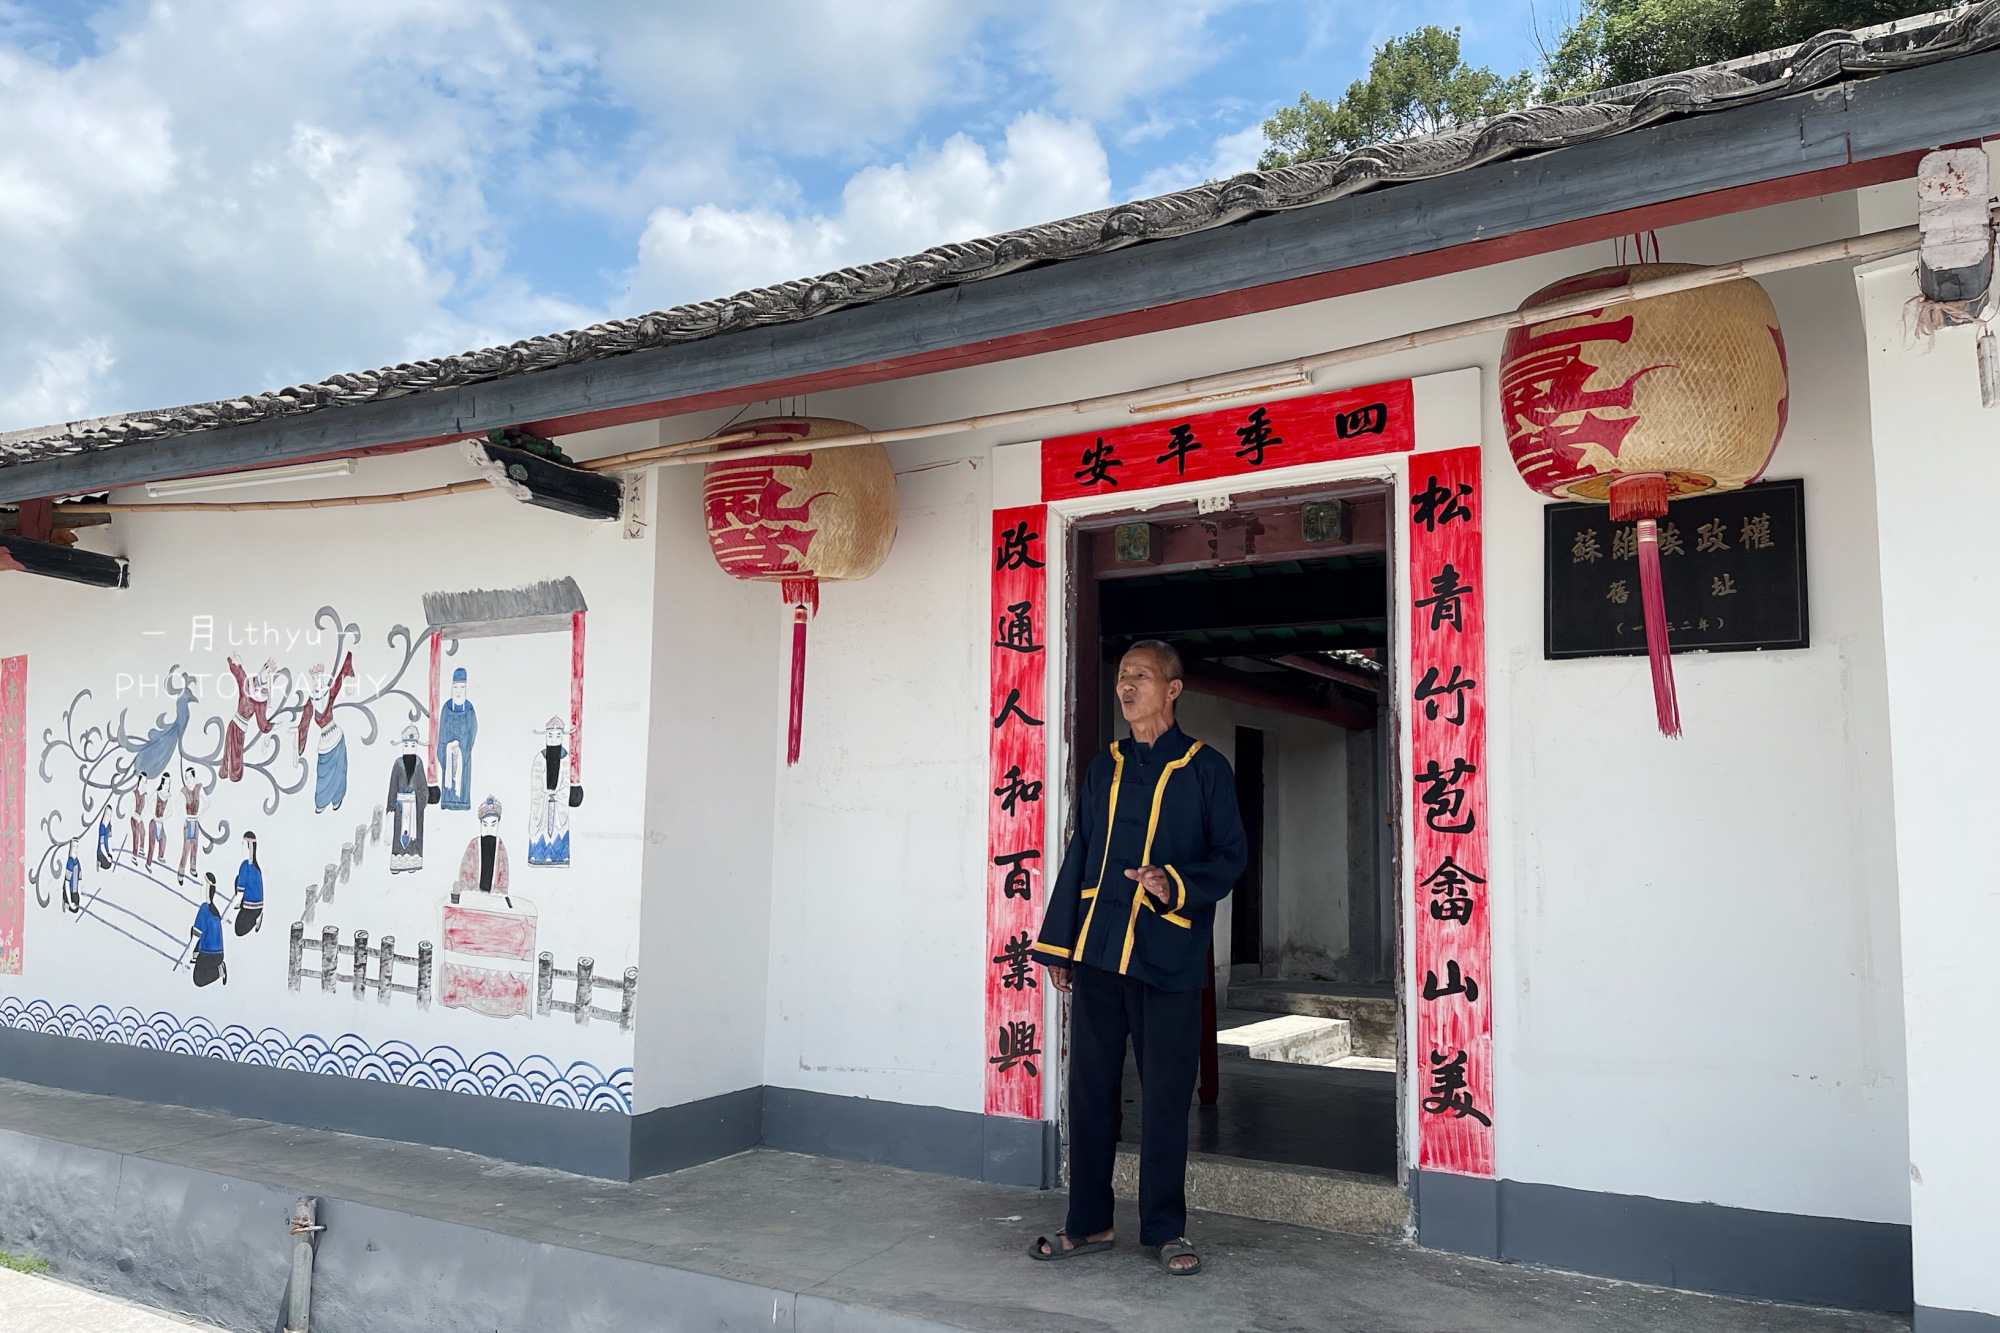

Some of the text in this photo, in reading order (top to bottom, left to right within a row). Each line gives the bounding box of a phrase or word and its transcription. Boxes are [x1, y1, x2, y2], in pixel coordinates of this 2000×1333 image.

[1616, 616, 1725, 635] （一三二年）
[989, 520, 1046, 1078] 政通人和百業興
